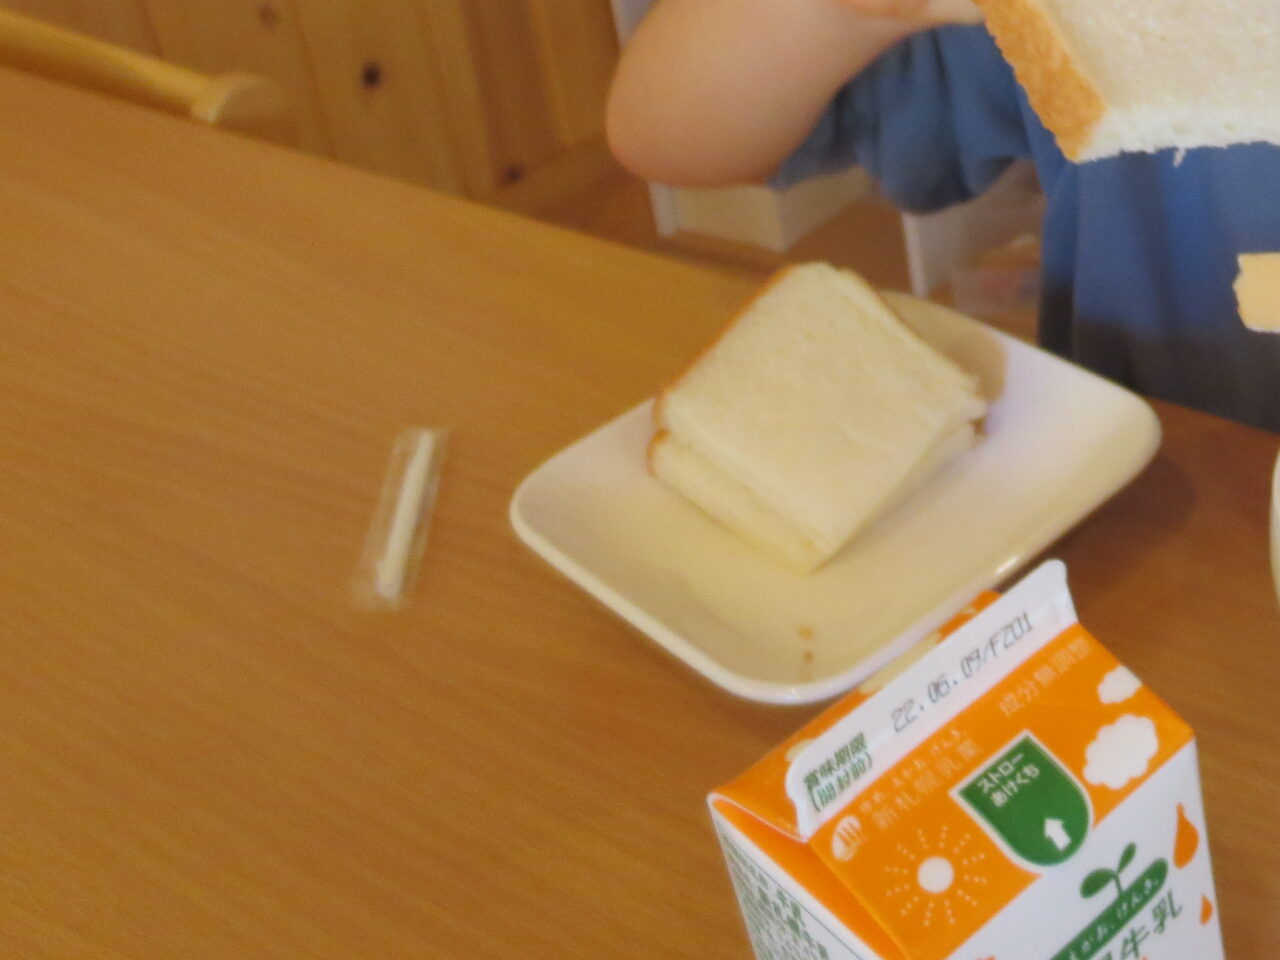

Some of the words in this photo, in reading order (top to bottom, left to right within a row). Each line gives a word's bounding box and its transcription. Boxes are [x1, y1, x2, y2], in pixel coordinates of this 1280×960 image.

[803, 732, 867, 788] 賞味期限
[977, 753, 1024, 794] ストロー
[991, 763, 1040, 807] あけくち
